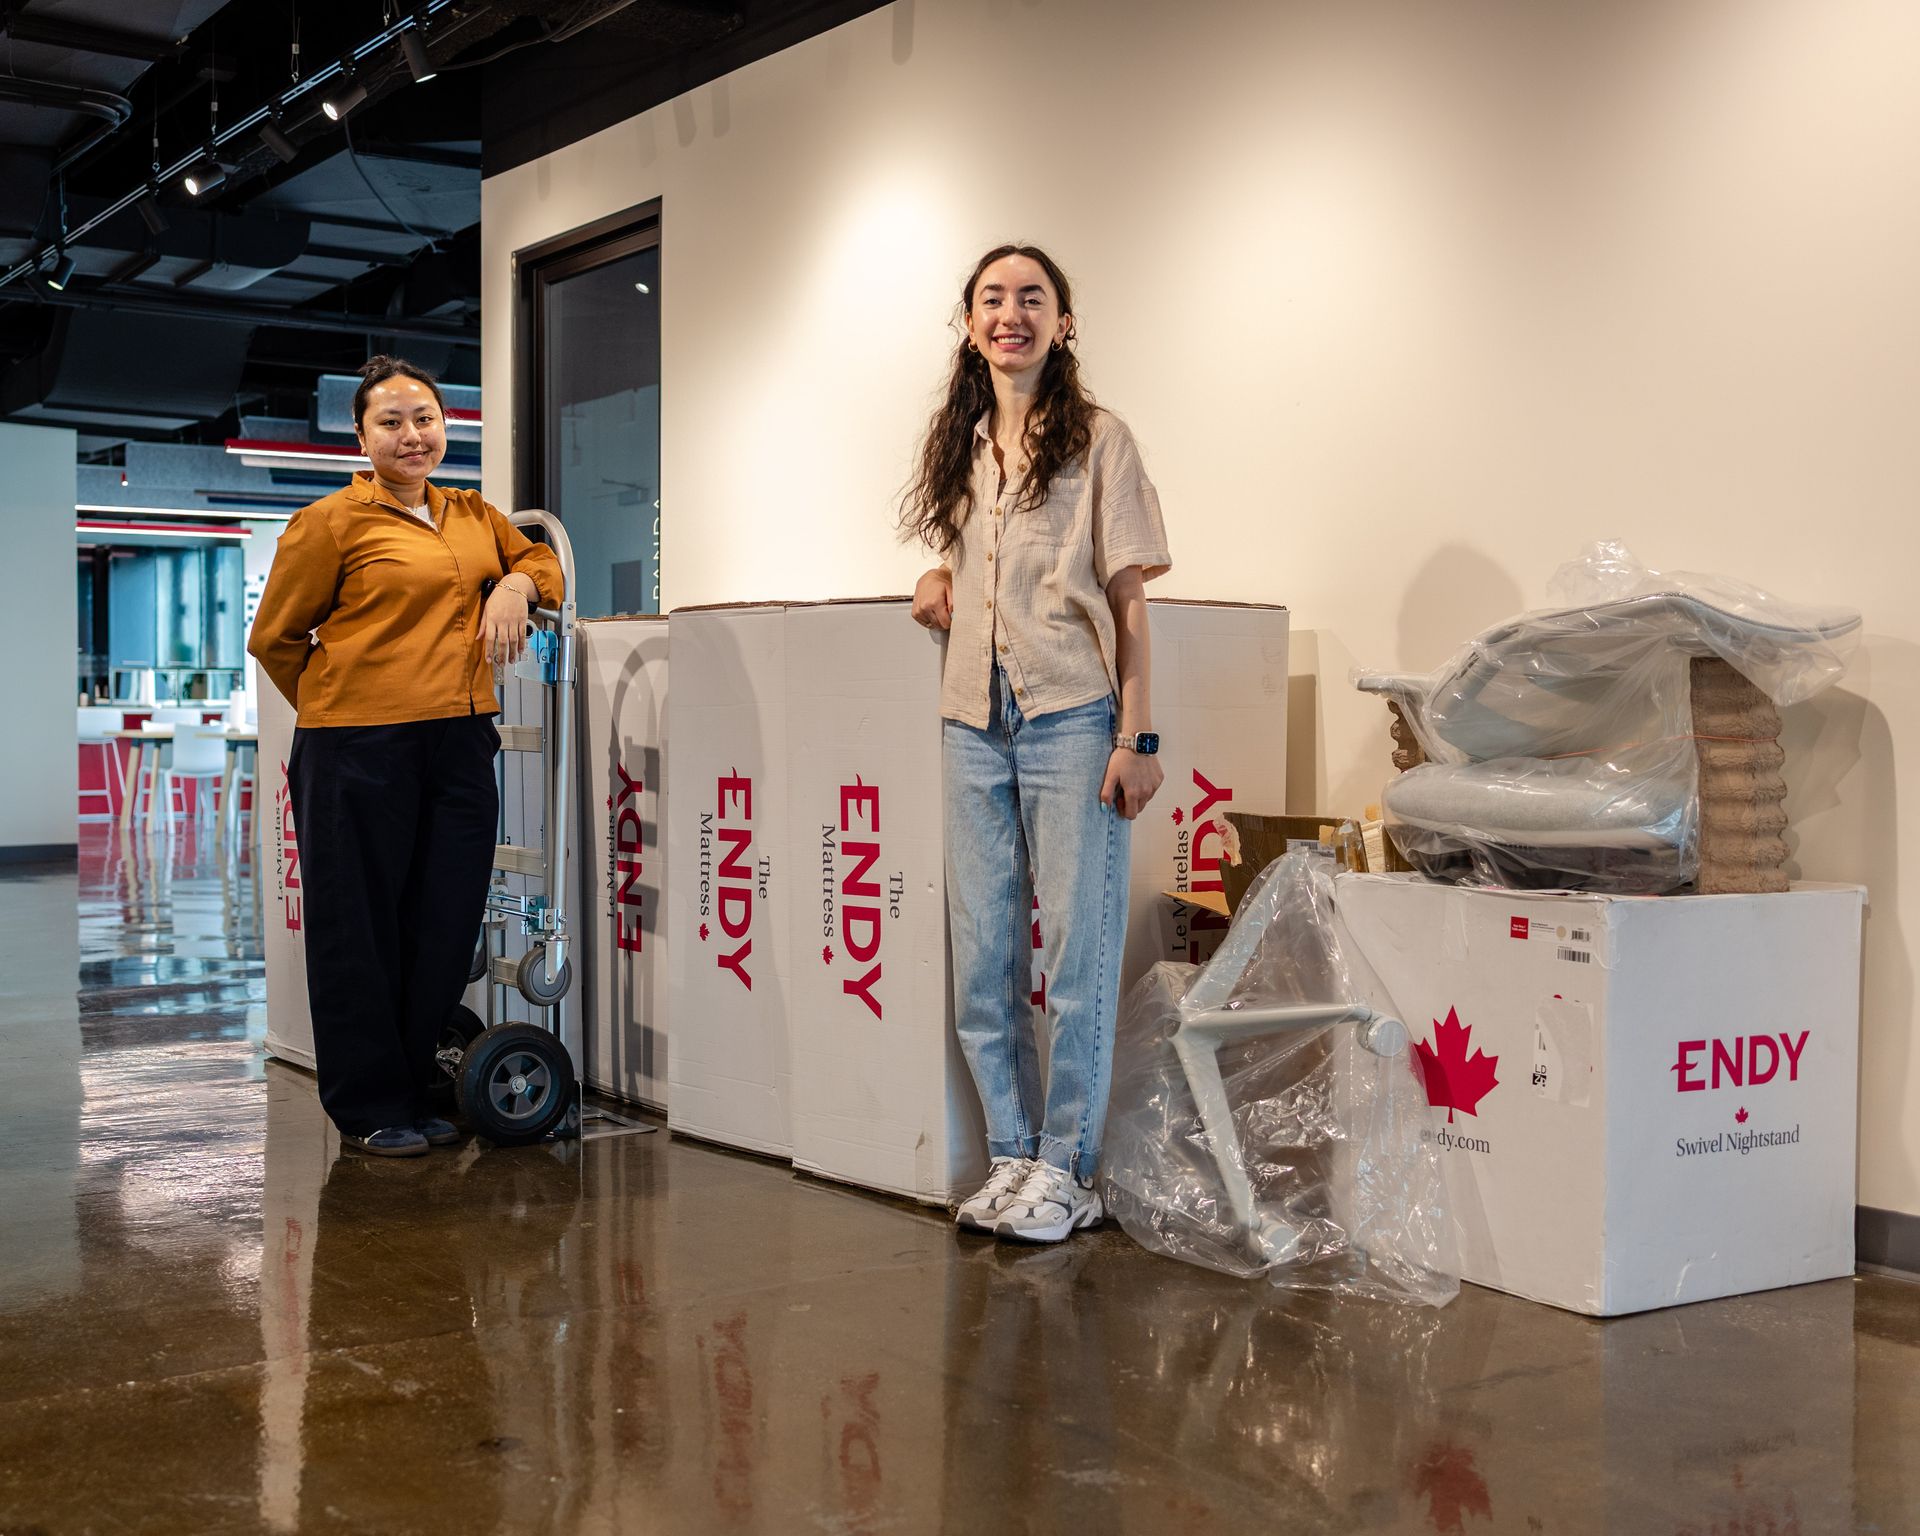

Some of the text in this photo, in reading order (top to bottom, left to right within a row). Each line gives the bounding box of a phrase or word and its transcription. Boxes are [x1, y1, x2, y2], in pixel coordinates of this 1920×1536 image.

[274, 807, 284, 901] Le Matelas
[606, 815, 615, 919] Le Matelas
[617, 762, 643, 960] ENDY
[699, 812, 713, 916] Mattress
[717, 766, 753, 992] ENDY
[758, 856, 771, 899] The
[821, 823, 836, 937] Mattress
[839, 773, 883, 1021] ENDY
[889, 871, 904, 919] The
[1172, 830, 1189, 952] Le Matelas
[1189, 767, 1233, 965] NDY
[1670, 1030, 1810, 1093] ENDY
[1420, 1127, 1491, 1153] dy.com
[1676, 1123, 1800, 1157] Swivel Nightstand
